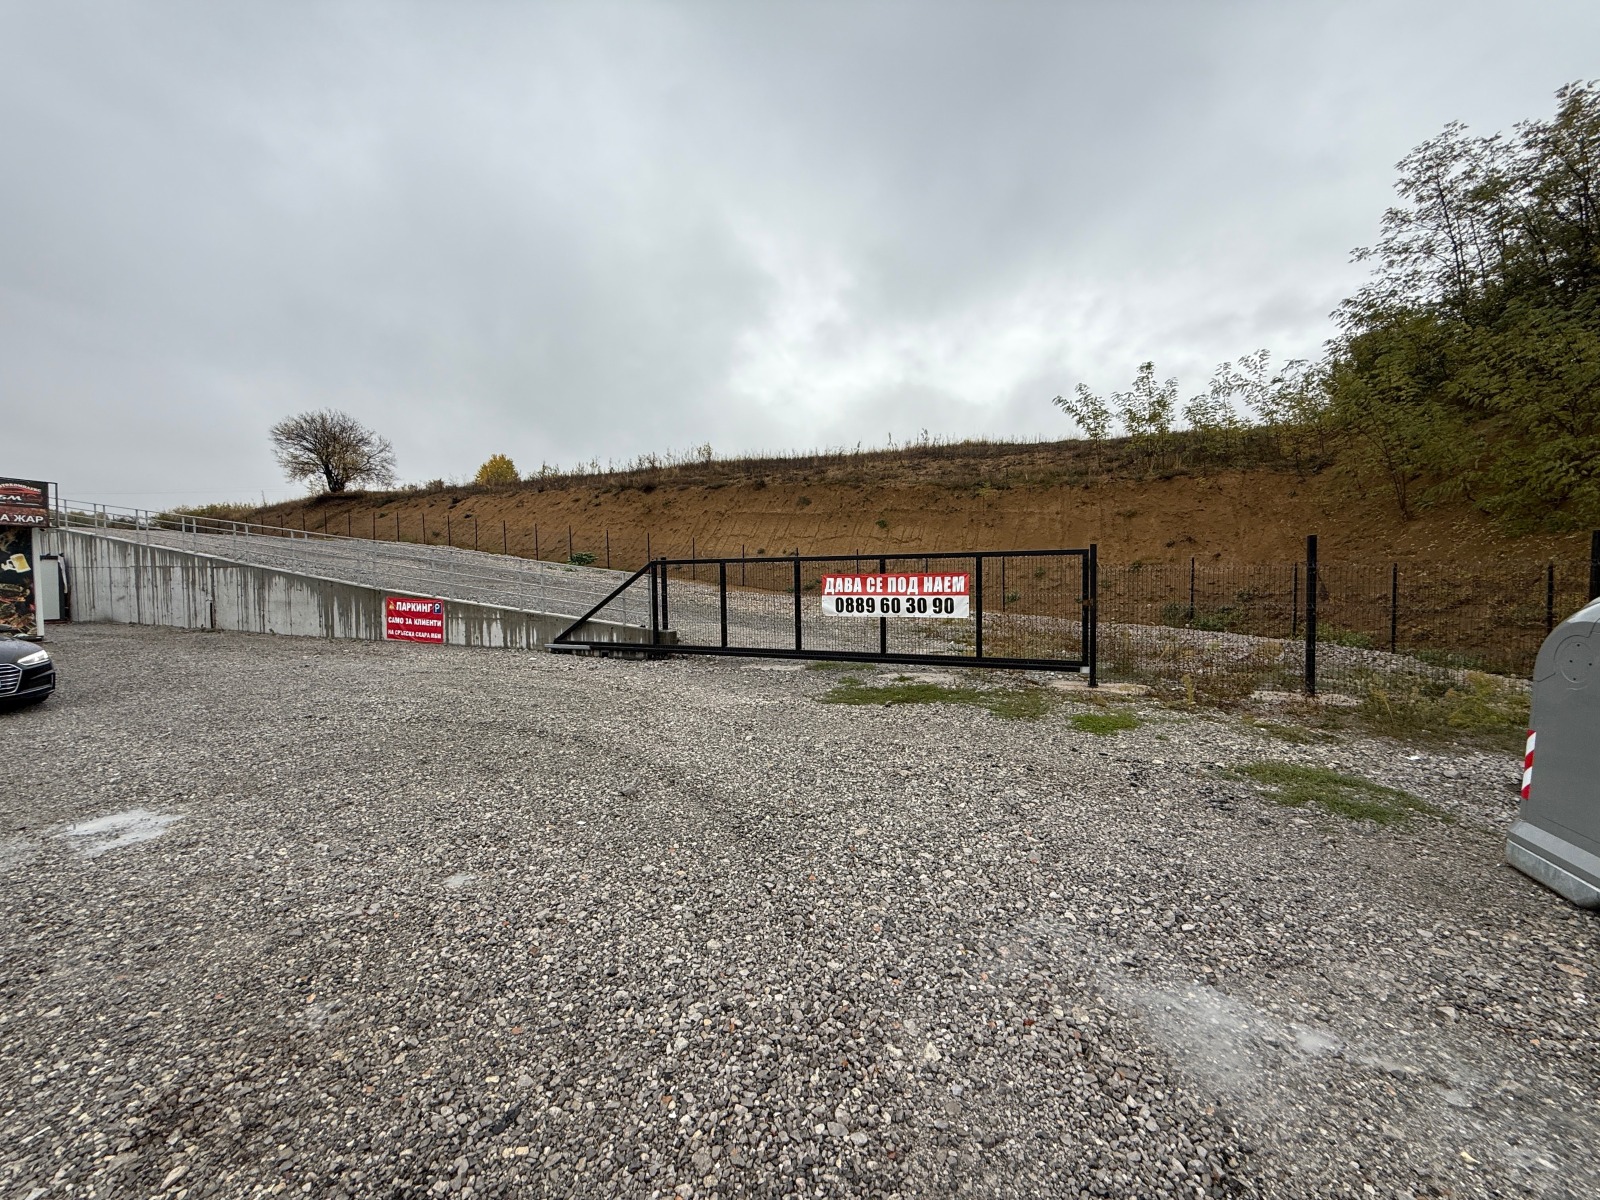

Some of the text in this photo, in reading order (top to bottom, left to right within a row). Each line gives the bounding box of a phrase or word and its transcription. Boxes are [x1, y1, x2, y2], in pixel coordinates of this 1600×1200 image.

[0, 513, 44, 523] А ЖАР
[824, 575, 965, 595] ДАВА СЕ ПОД НАЕМ
[396, 602, 432, 612] ПАРКИНГ
[835, 597, 955, 614] 0889 60 30 90
[414, 619, 442, 627] КЛИЕНТИ
